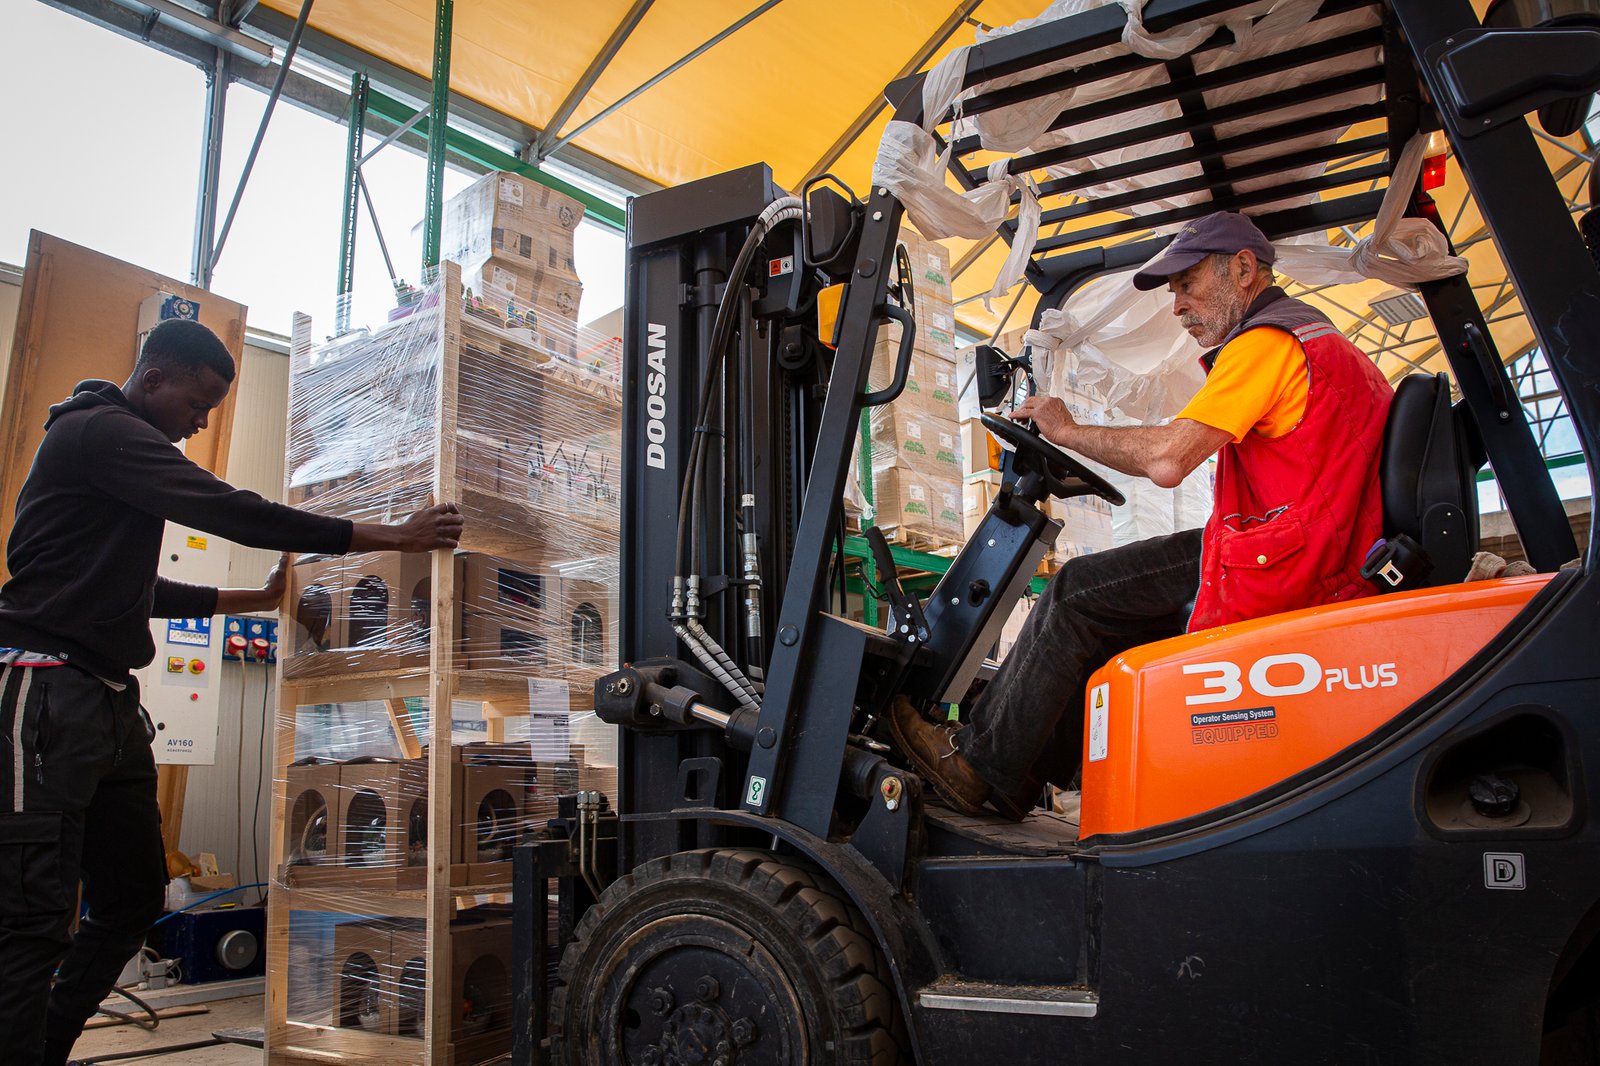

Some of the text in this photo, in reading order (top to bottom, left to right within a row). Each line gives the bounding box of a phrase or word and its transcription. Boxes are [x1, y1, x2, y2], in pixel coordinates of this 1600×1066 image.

[647, 323, 666, 470] DOOSAN
[1182, 653, 1398, 706] 30 PLUS
[1192, 710, 1274, 725] Operator Sensing System
[167, 738, 194, 747] AV160
[1192, 722, 1279, 745] EQUIPPED
[1493, 859, 1516, 882] D
